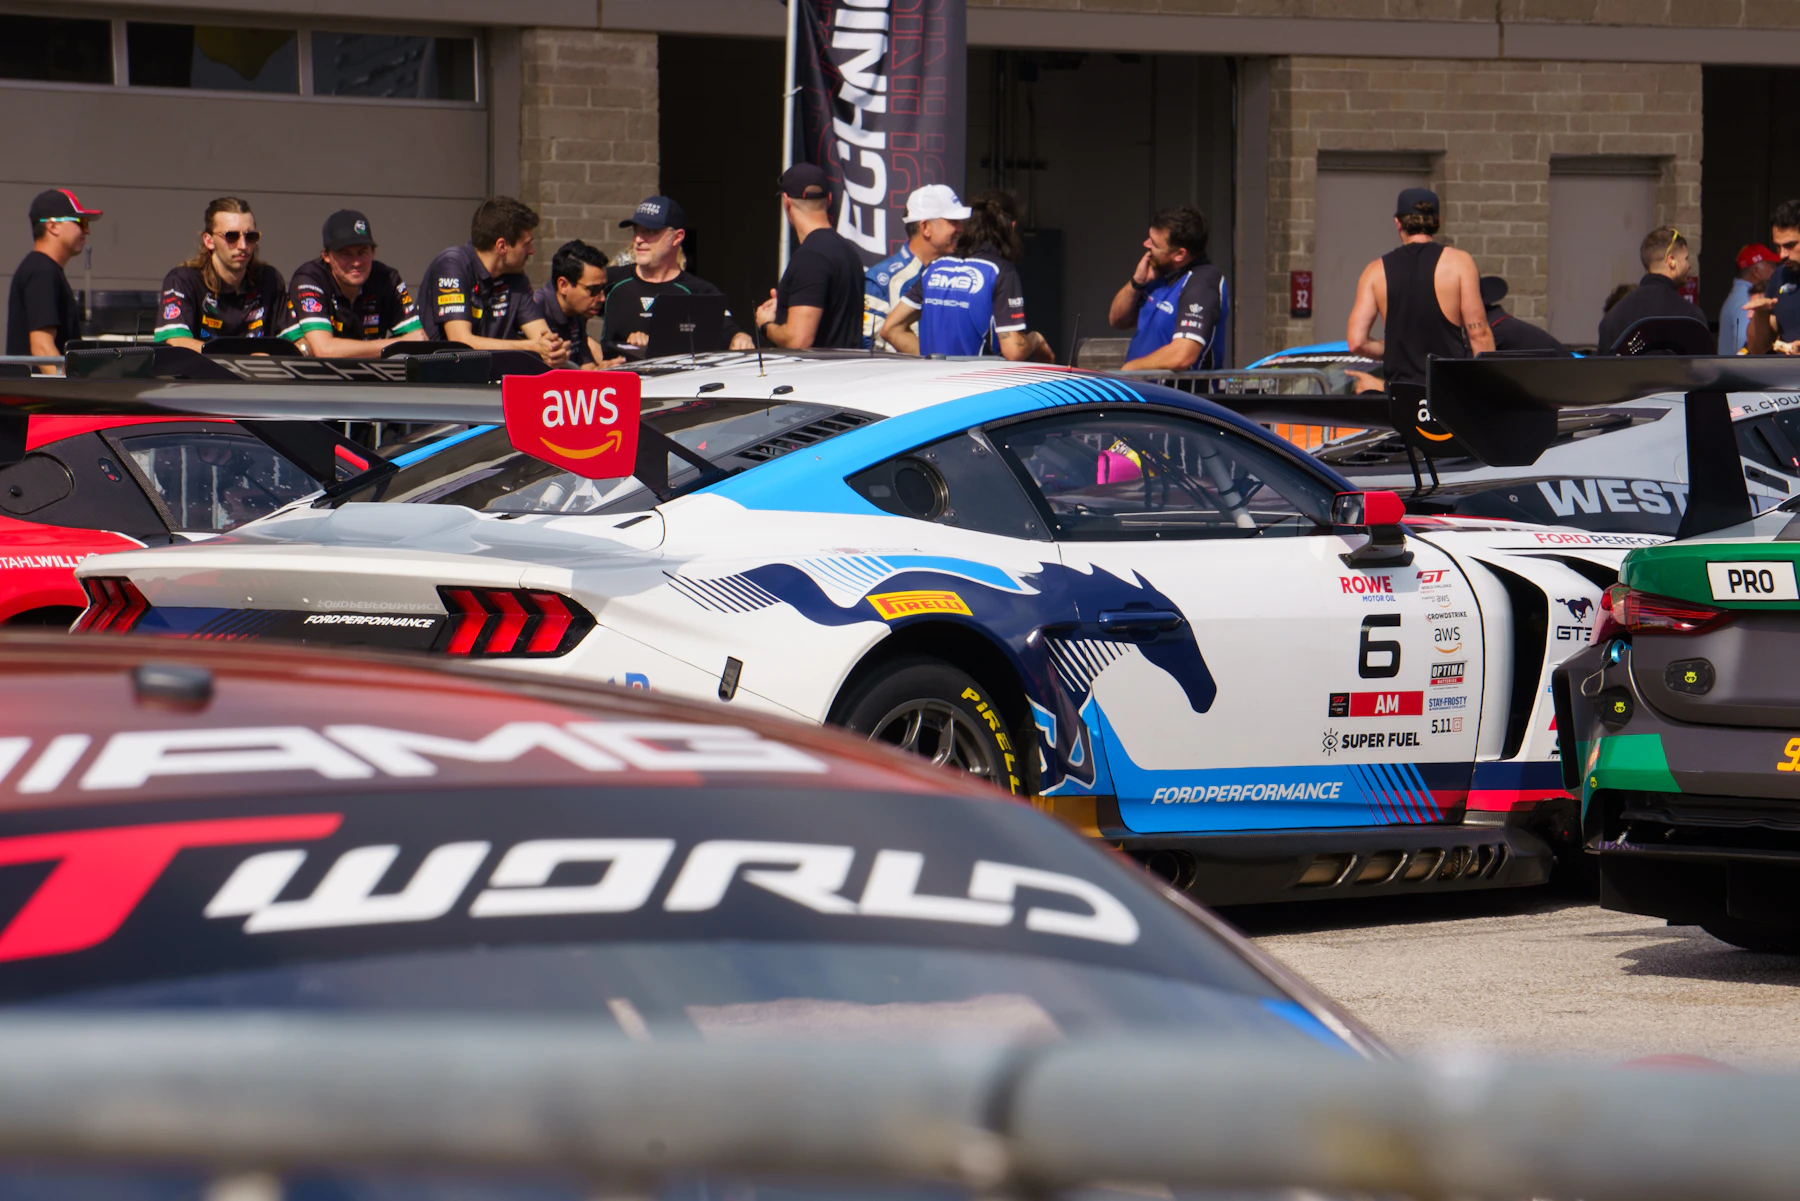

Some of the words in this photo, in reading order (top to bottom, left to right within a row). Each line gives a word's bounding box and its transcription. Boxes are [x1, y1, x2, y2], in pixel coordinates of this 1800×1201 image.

[832, 0, 889, 256] ECHNI
[924, 298, 969, 308] PORSCHE
[207, 359, 406, 381] RSCHE
[542, 387, 619, 428] aws
[1743, 405, 1757, 413] R.
[1759, 396, 1800, 409] CHOU
[1534, 533, 1665, 546] FORDPERFO
[1338, 575, 1393, 594] ROWE
[1728, 569, 1774, 593] PRO
[882, 592, 964, 617] PIRELLI
[1436, 595, 1450, 603] aws
[304, 615, 436, 629] FORDPERFORMANCE
[1427, 611, 1467, 620] CROWDSTRIKE
[1434, 626, 1461, 642] aws
[1358, 613, 1401, 679] 6
[1432, 664, 1463, 677] OPTIMA
[1374, 694, 1399, 714] AM
[1429, 696, 1467, 707] STAY-FROSTY
[1431, 718, 1451, 733] 5.11
[961, 687, 1020, 796] PIRELL
[1341, 733, 1385, 749] SUPER
[1388, 731, 1420, 748] FUEL
[1776, 737, 1800, 772] 9
[1151, 782, 1343, 804] FORDPERFORMANCE
[0, 813, 344, 962] T
[203, 837, 1140, 946] WORLD
